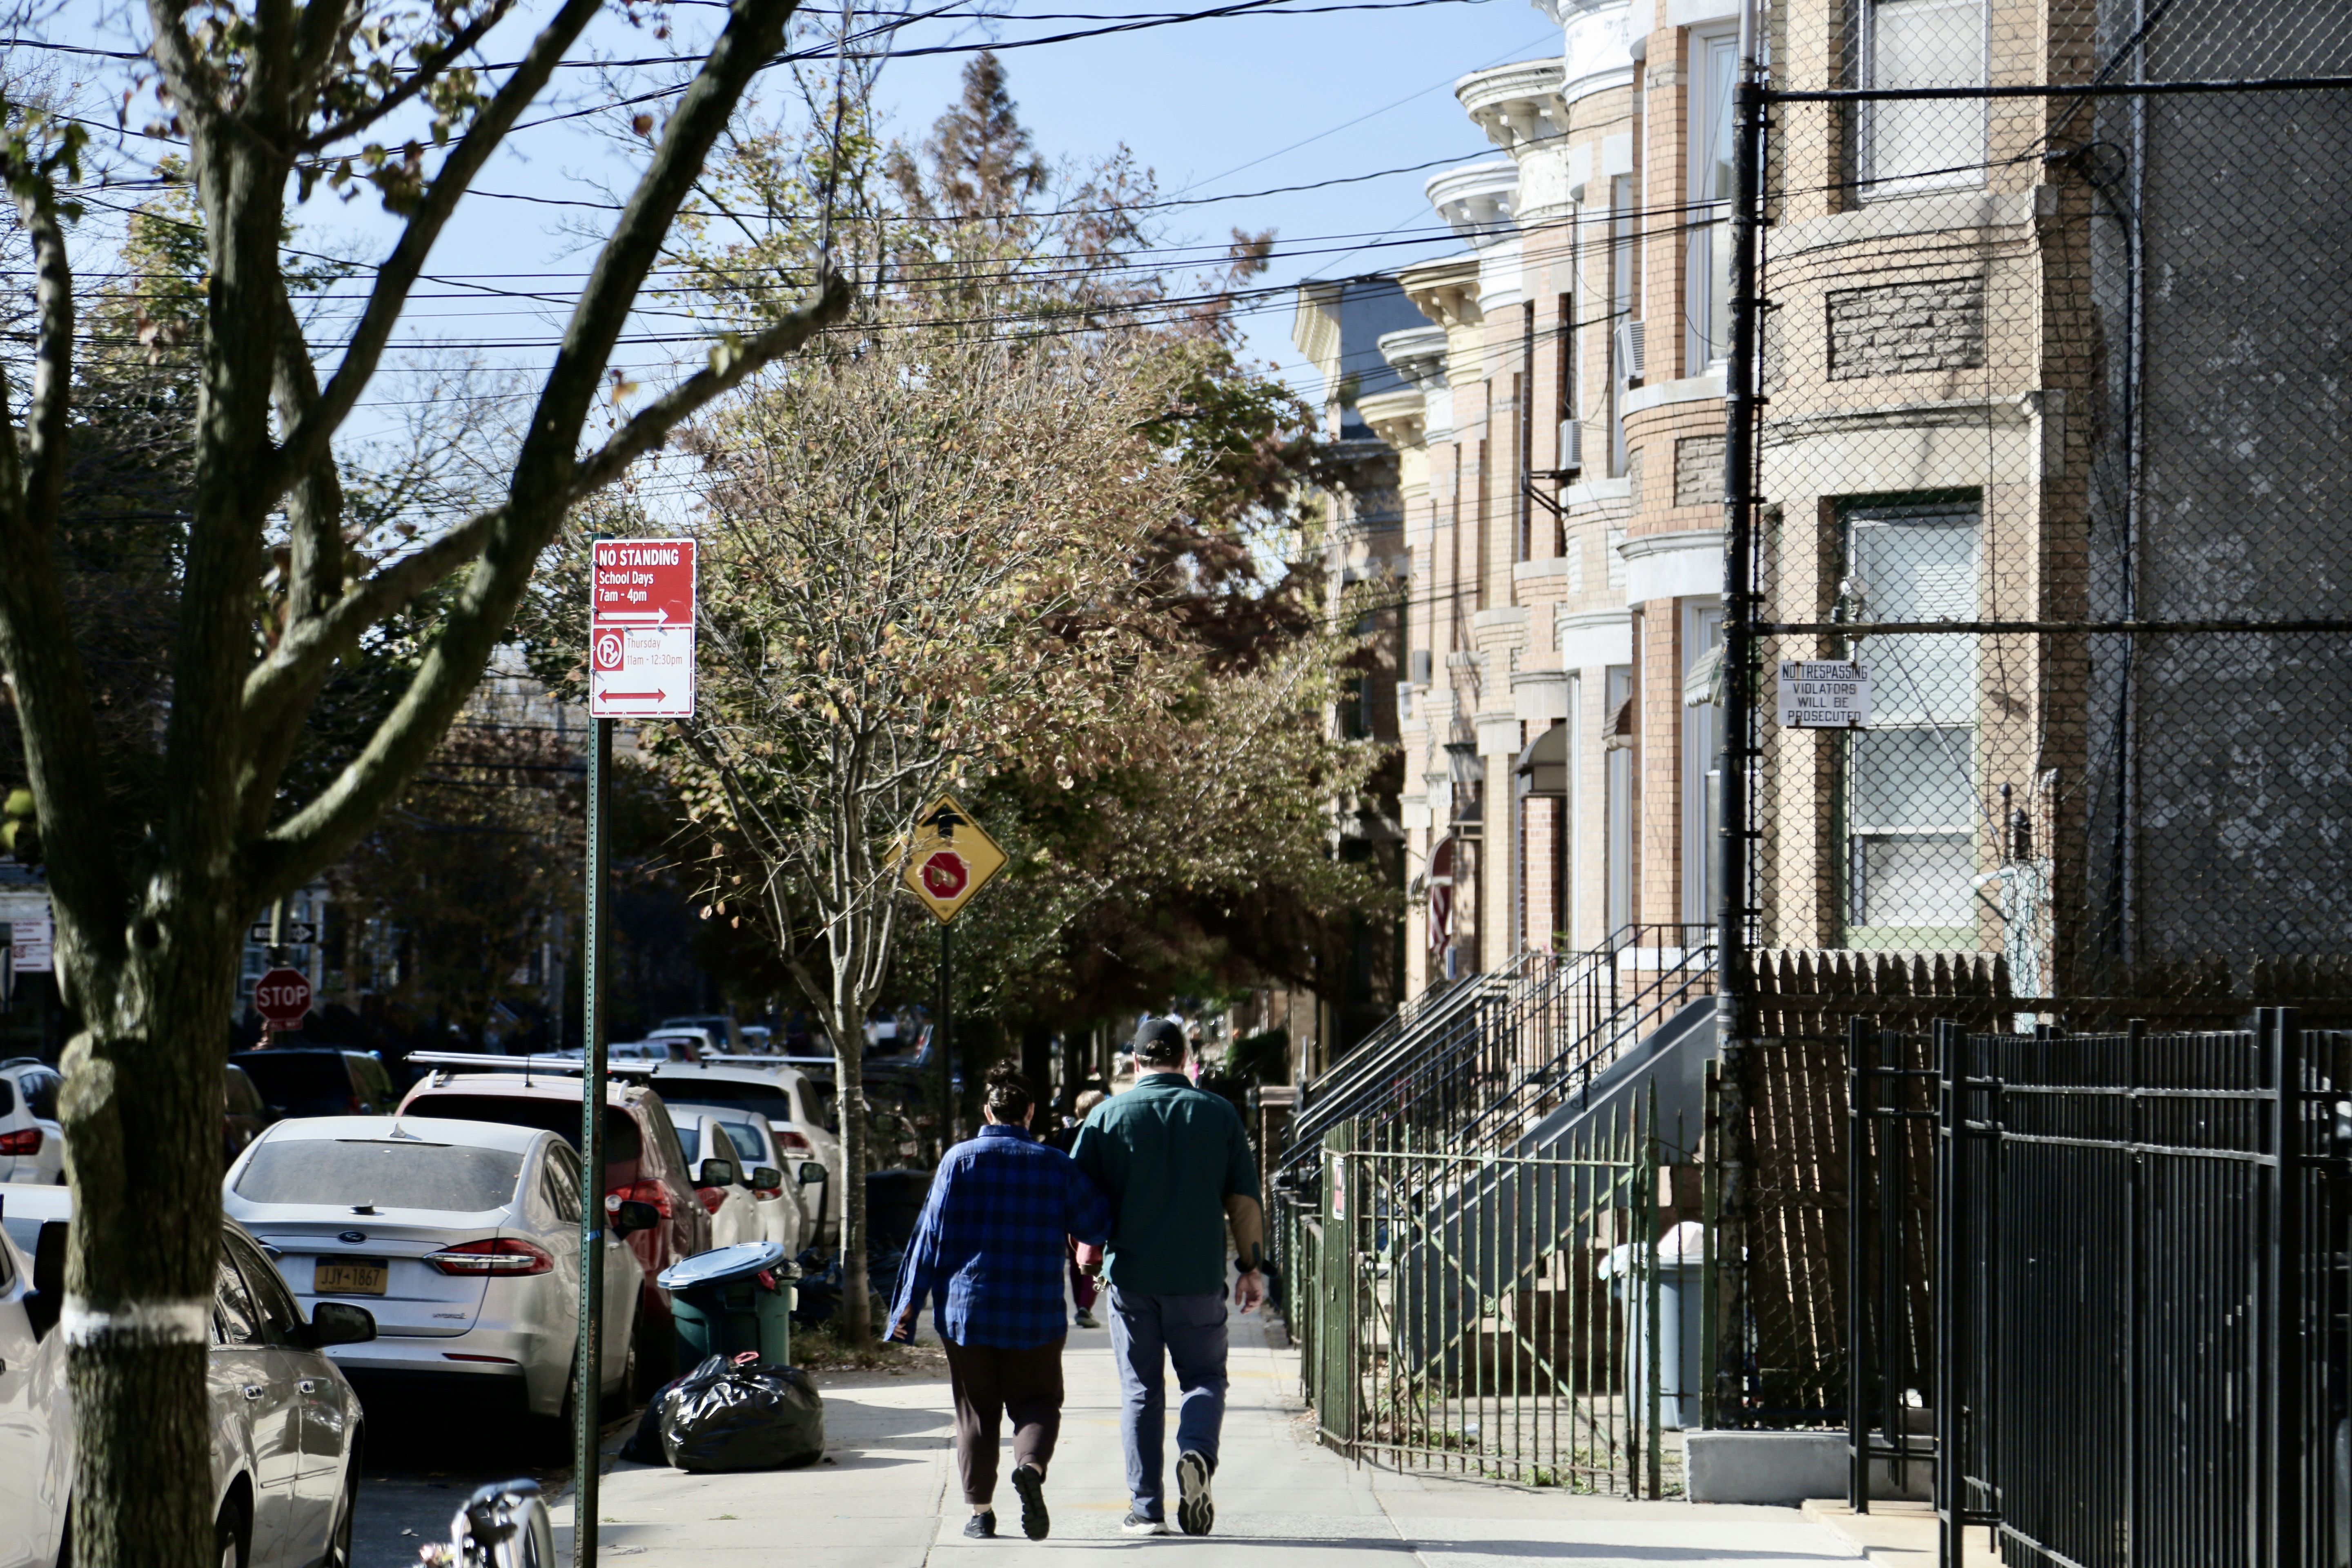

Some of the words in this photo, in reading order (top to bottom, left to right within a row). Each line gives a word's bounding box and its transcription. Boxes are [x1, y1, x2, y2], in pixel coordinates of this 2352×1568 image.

[599, 550, 617, 566] NO
[619, 549, 679, 566] STANDING
[599, 571, 630, 585] School
[632, 571, 654, 587] Days
[599, 588, 618, 602] 7am
[627, 588, 647, 604] 4pm
[627, 638, 661, 650] Thursday
[627, 655, 644, 666] 11am
[652, 655, 682, 667] 12:30pm
[1783, 665, 1795, 679] NO
[1801, 665, 1867, 679] TRESPASSING
[1793, 683, 1855, 694] VIOLATORS
[1798, 697, 1826, 708] WILL
[1834, 697, 1849, 708] BE
[1788, 710, 1861, 722] PROSECUTED
[259, 985, 309, 1007] STOP
[321, 1267, 343, 1285] JJY
[353, 1268, 380, 1286] 1867
